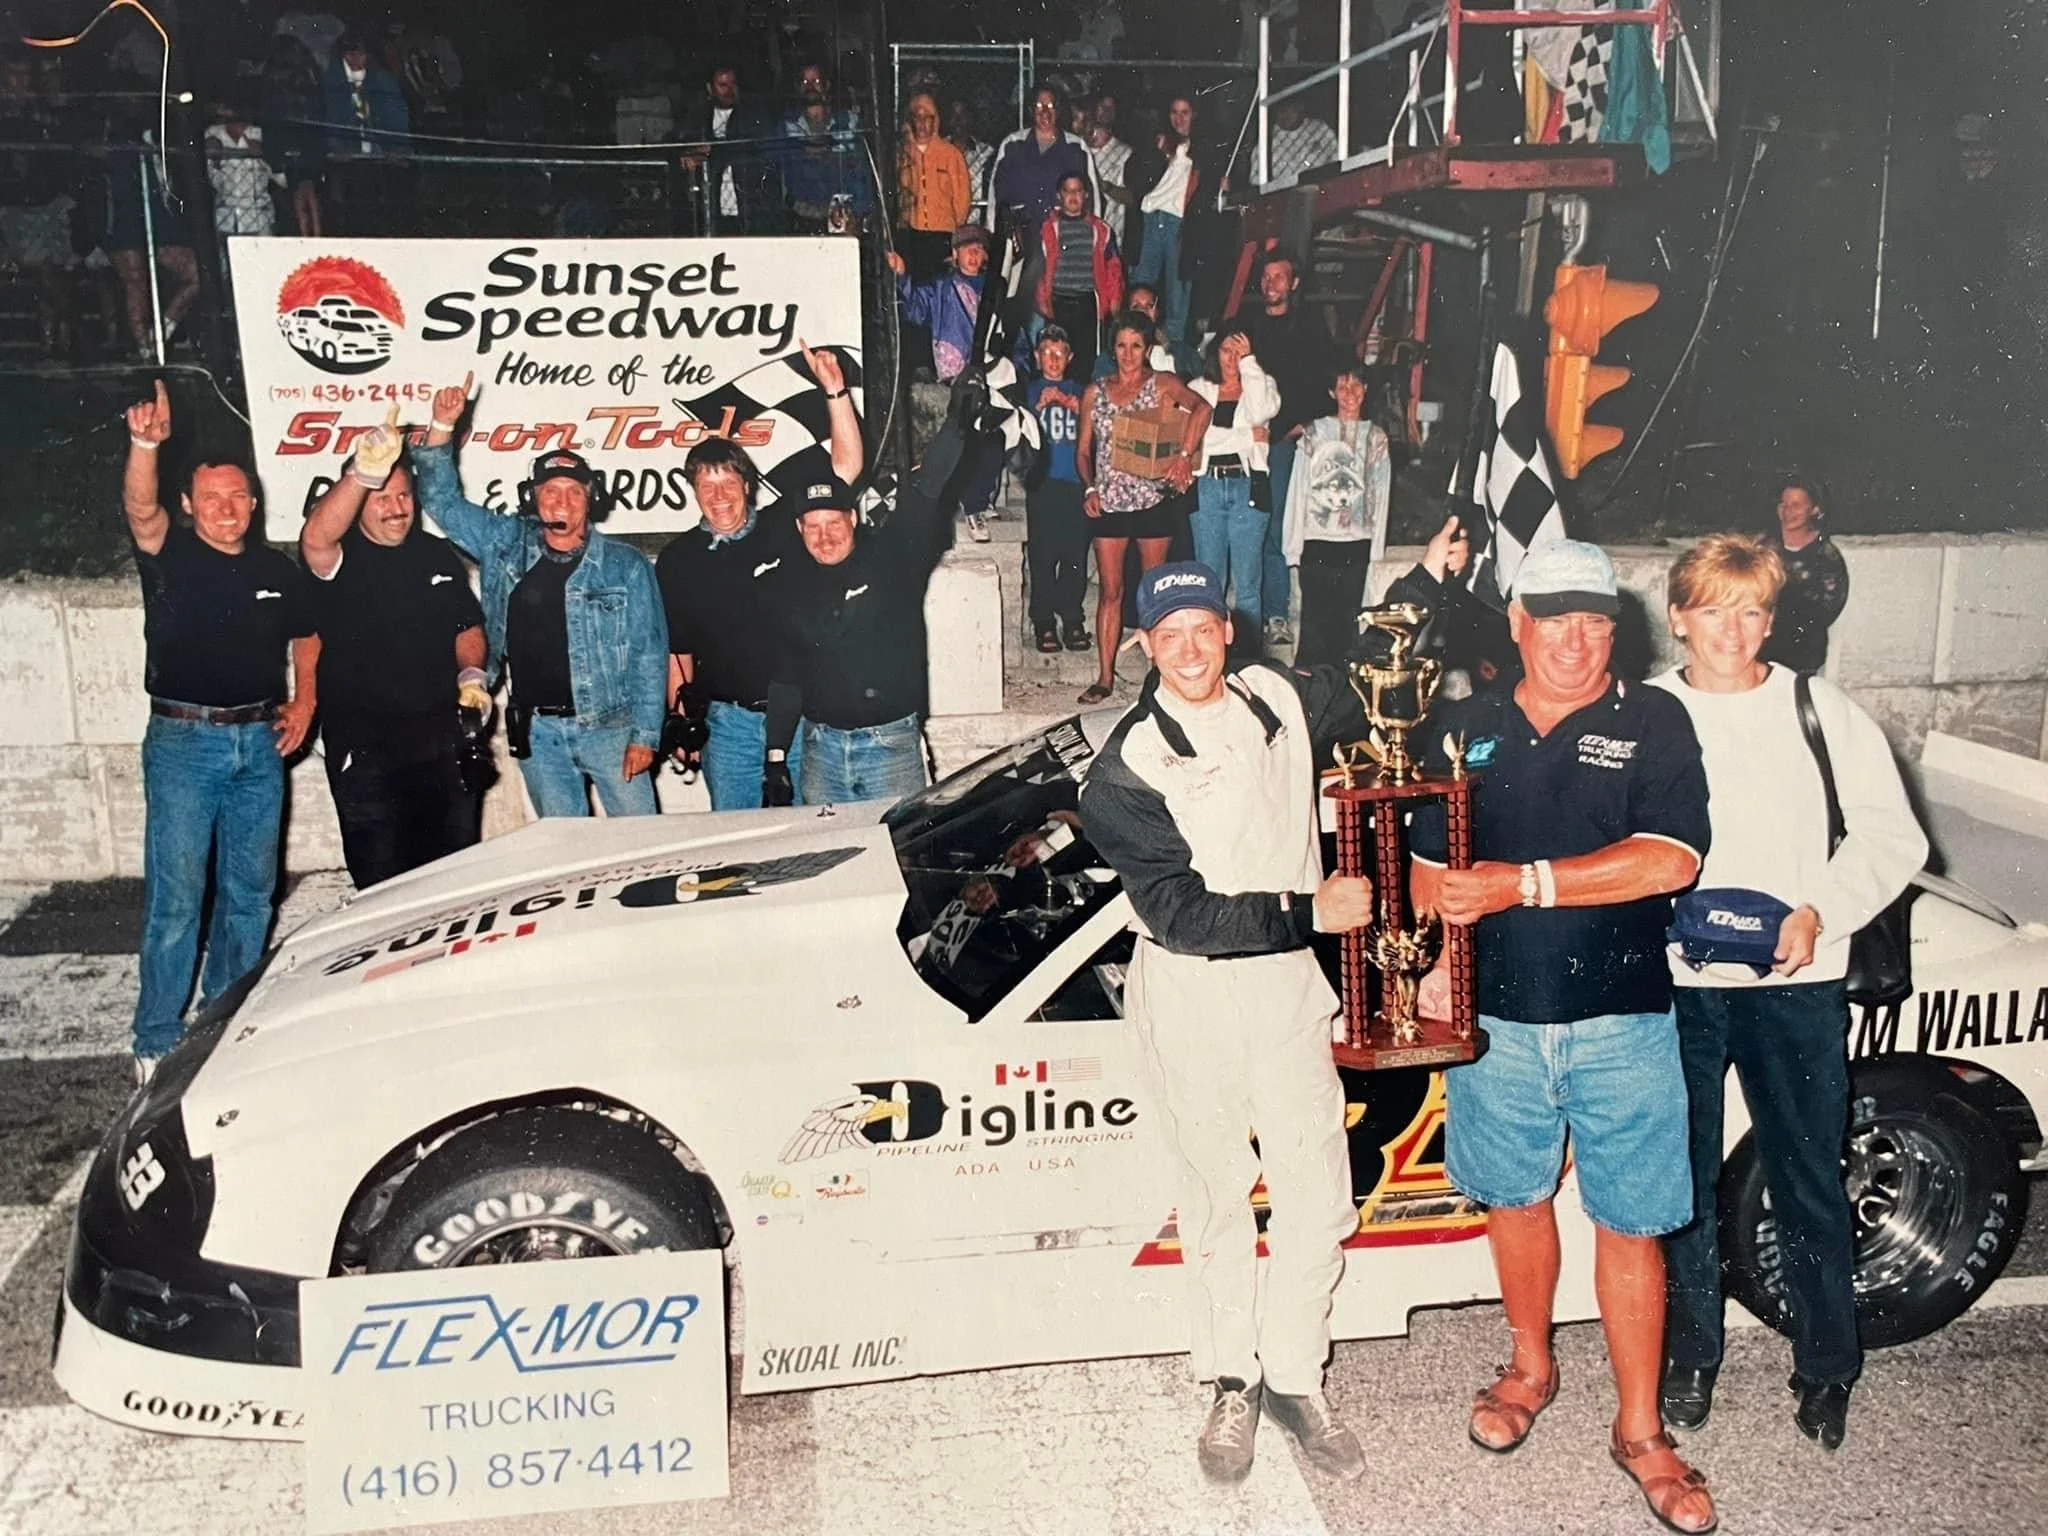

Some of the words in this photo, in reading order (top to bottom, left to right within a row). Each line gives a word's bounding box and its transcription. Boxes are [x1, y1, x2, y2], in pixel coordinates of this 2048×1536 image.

[484, 247, 739, 300] Sunset
[421, 291, 799, 355] Speedway
[268, 385, 306, 403] (705)
[495, 351, 594, 387] Home
[608, 354, 649, 396] of
[663, 353, 716, 385] the
[587, 405, 776, 450] Tools
[852, 1079, 1139, 1147] Digline
[876, 1141, 971, 1158] PIPELINE
[1025, 1130, 1137, 1149] STRINGING
[1028, 1157, 1077, 1171] USA
[331, 1294, 700, 1376] FLEX-MOR
[758, 1343, 841, 1377] SKOAL
[421, 1388, 616, 1432] TRUCKING
[342, 1455, 459, 1507] (416)
